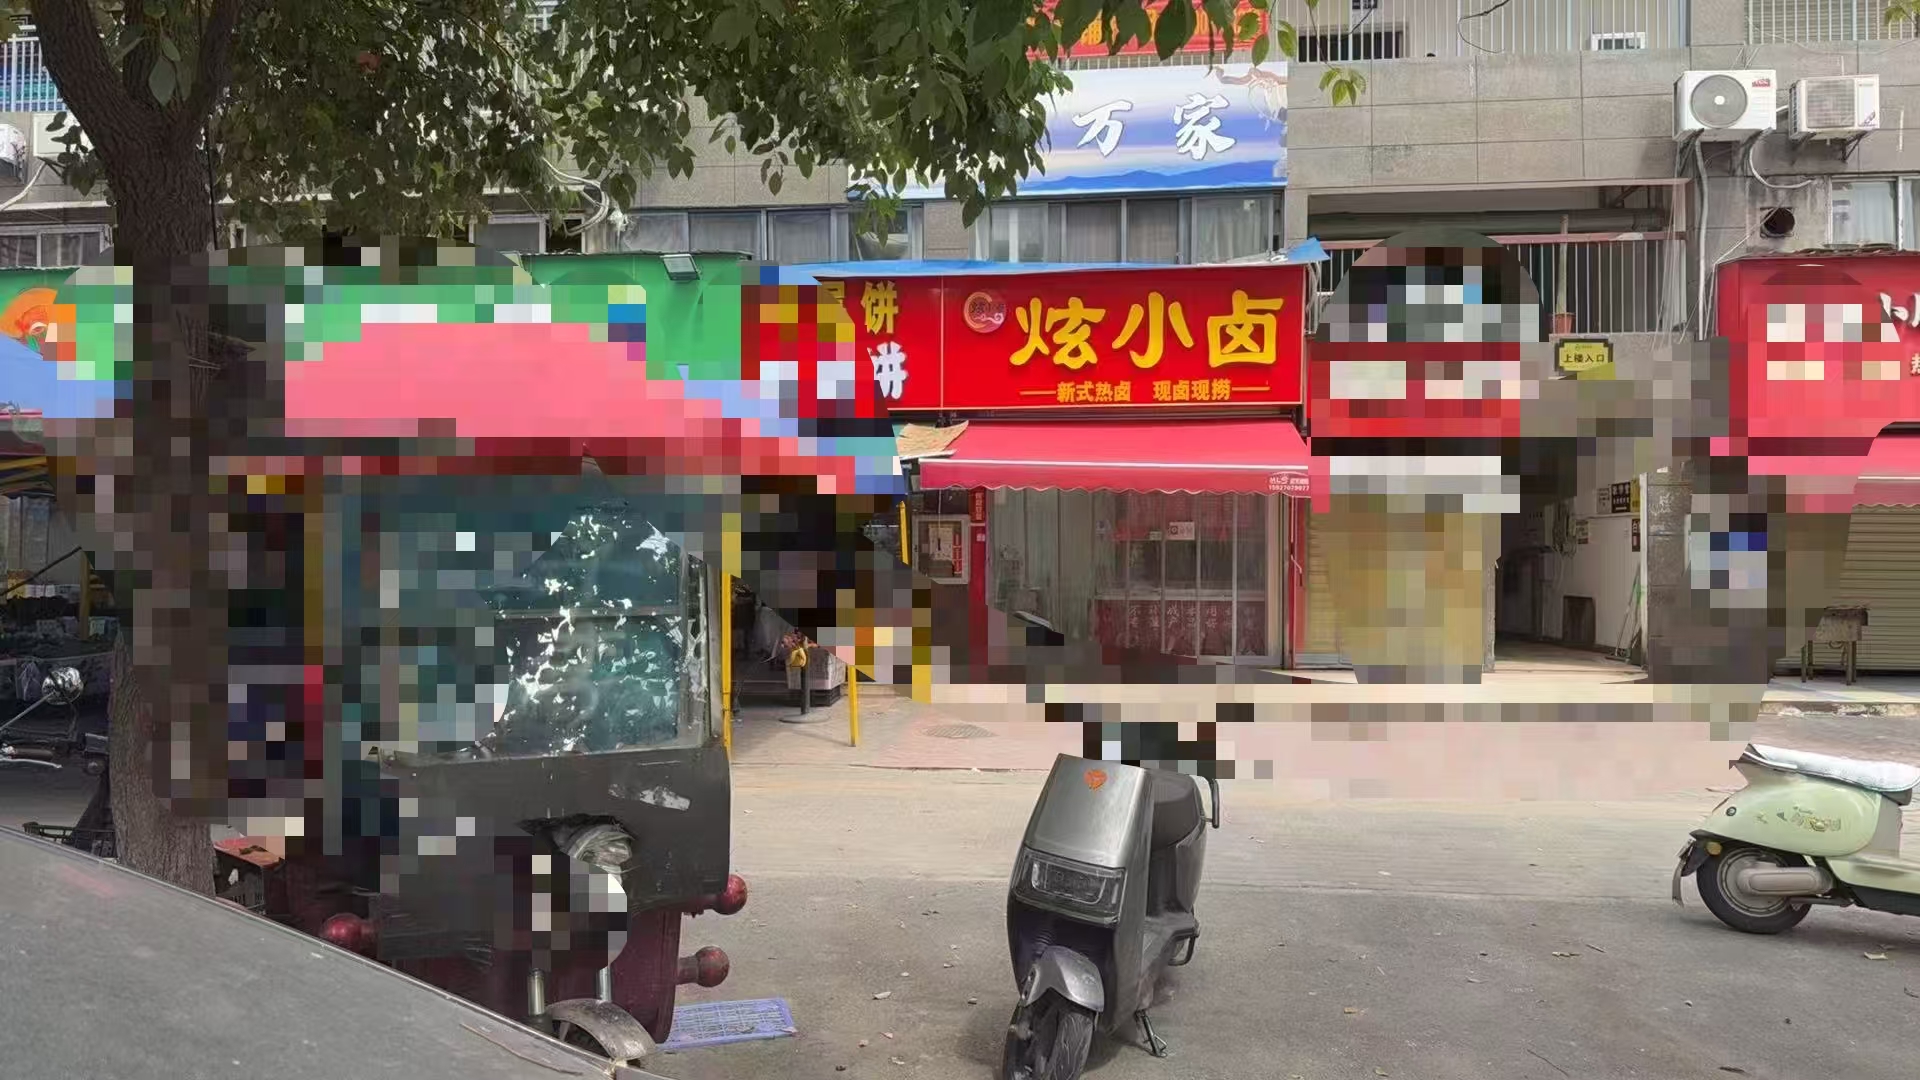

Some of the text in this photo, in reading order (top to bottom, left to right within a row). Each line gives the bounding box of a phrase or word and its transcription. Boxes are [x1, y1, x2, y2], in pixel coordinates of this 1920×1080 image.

[1072, 93, 1236, 160] 万家
[1010, 289, 1284, 370] 炫小卤
[1563, 353, 1605, 363] 上楼入口
[1057, 379, 1231, 403] 新式热卤 现卤现捞
